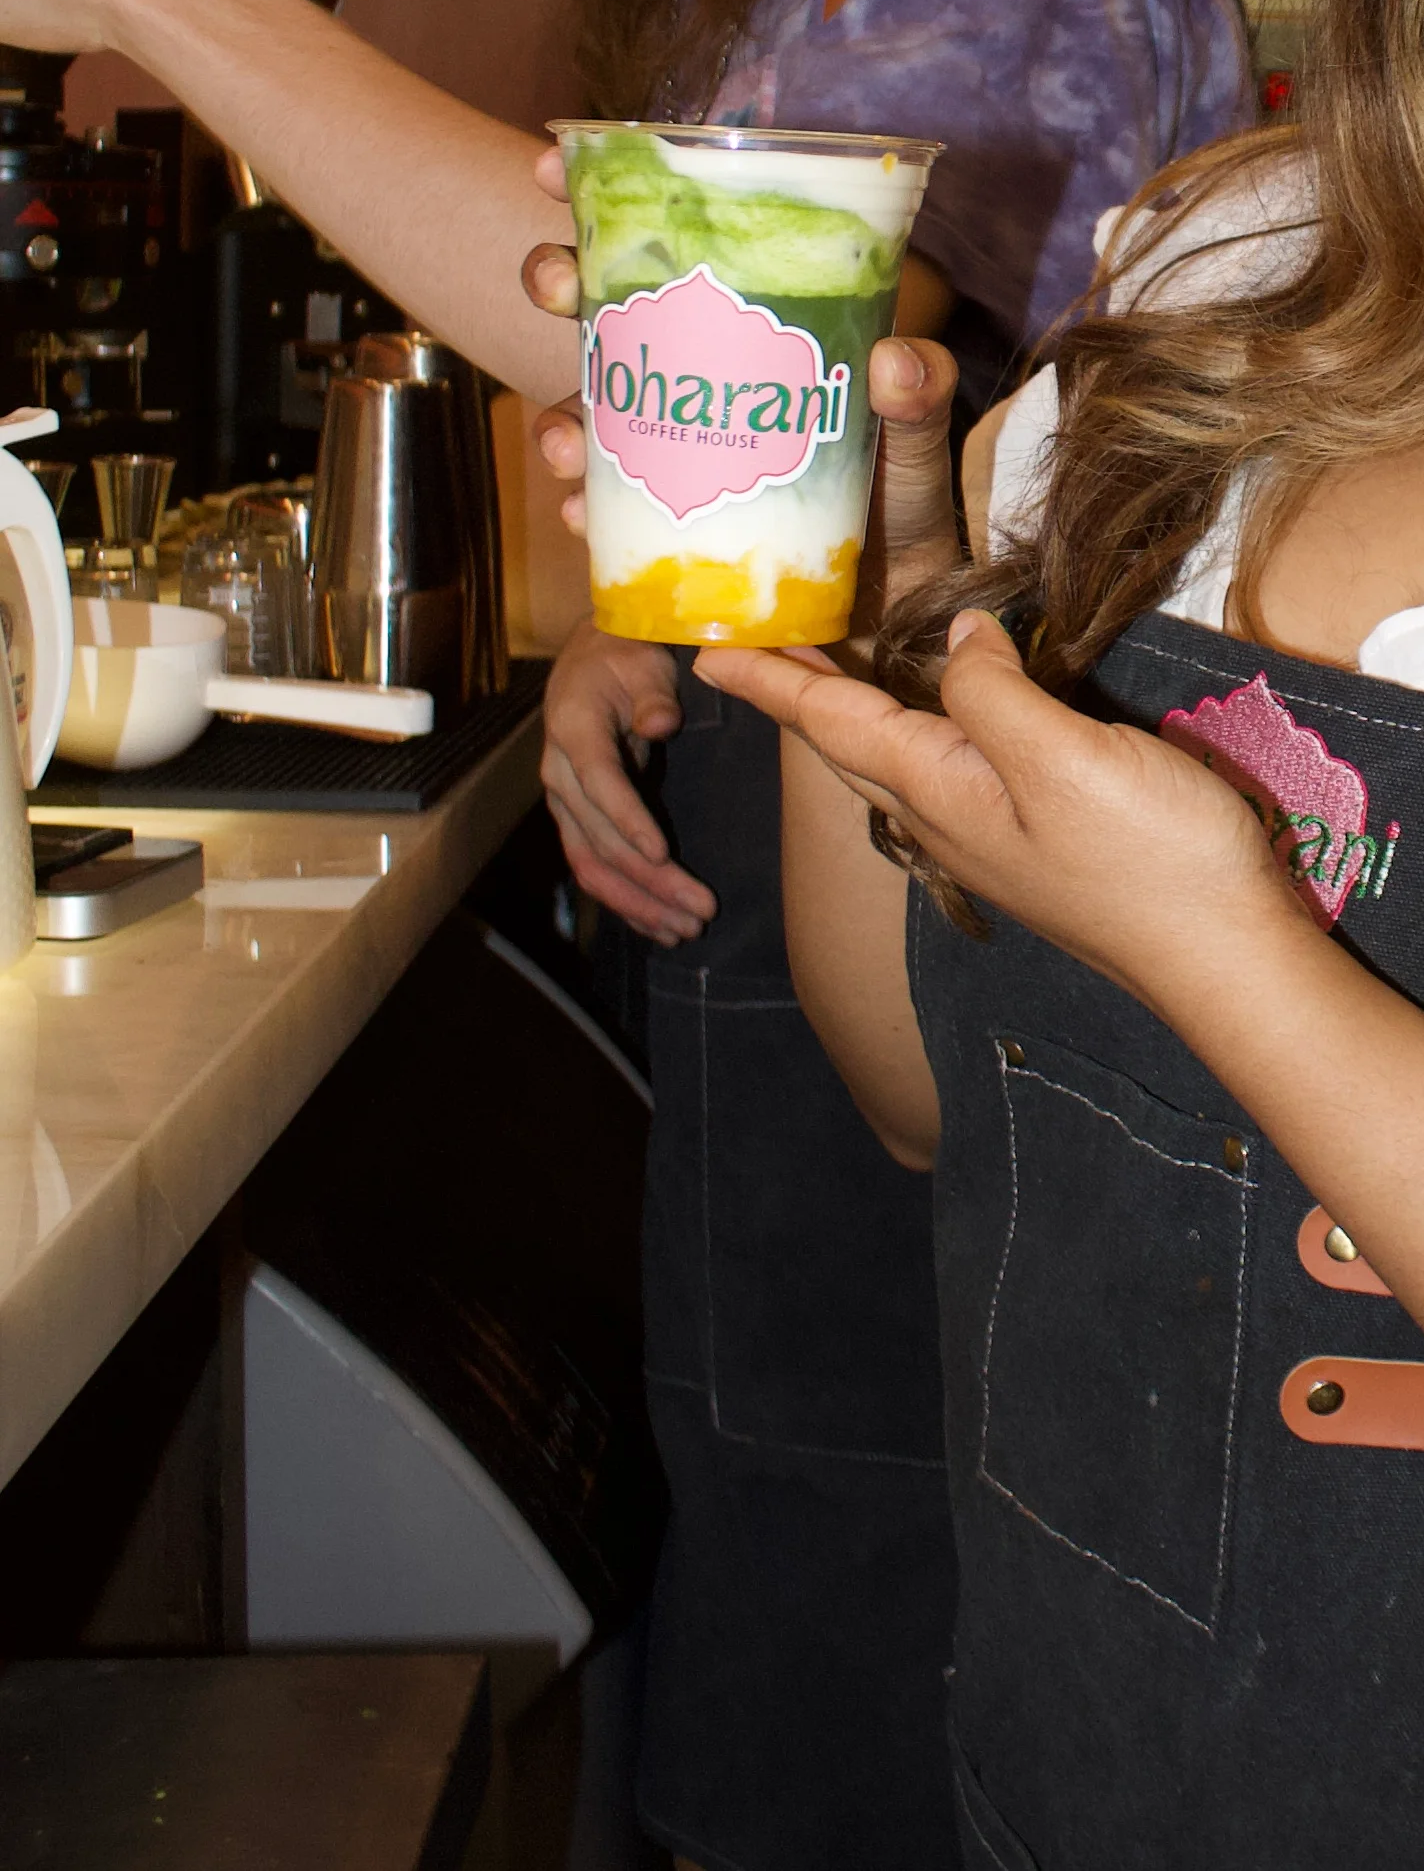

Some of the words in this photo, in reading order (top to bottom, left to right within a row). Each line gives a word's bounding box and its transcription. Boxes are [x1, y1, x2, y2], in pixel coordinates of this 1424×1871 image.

[582, 325, 842, 434] Moharani
[628, 419, 688, 442] COFFEE
[696, 431, 760, 450] HOUSE
